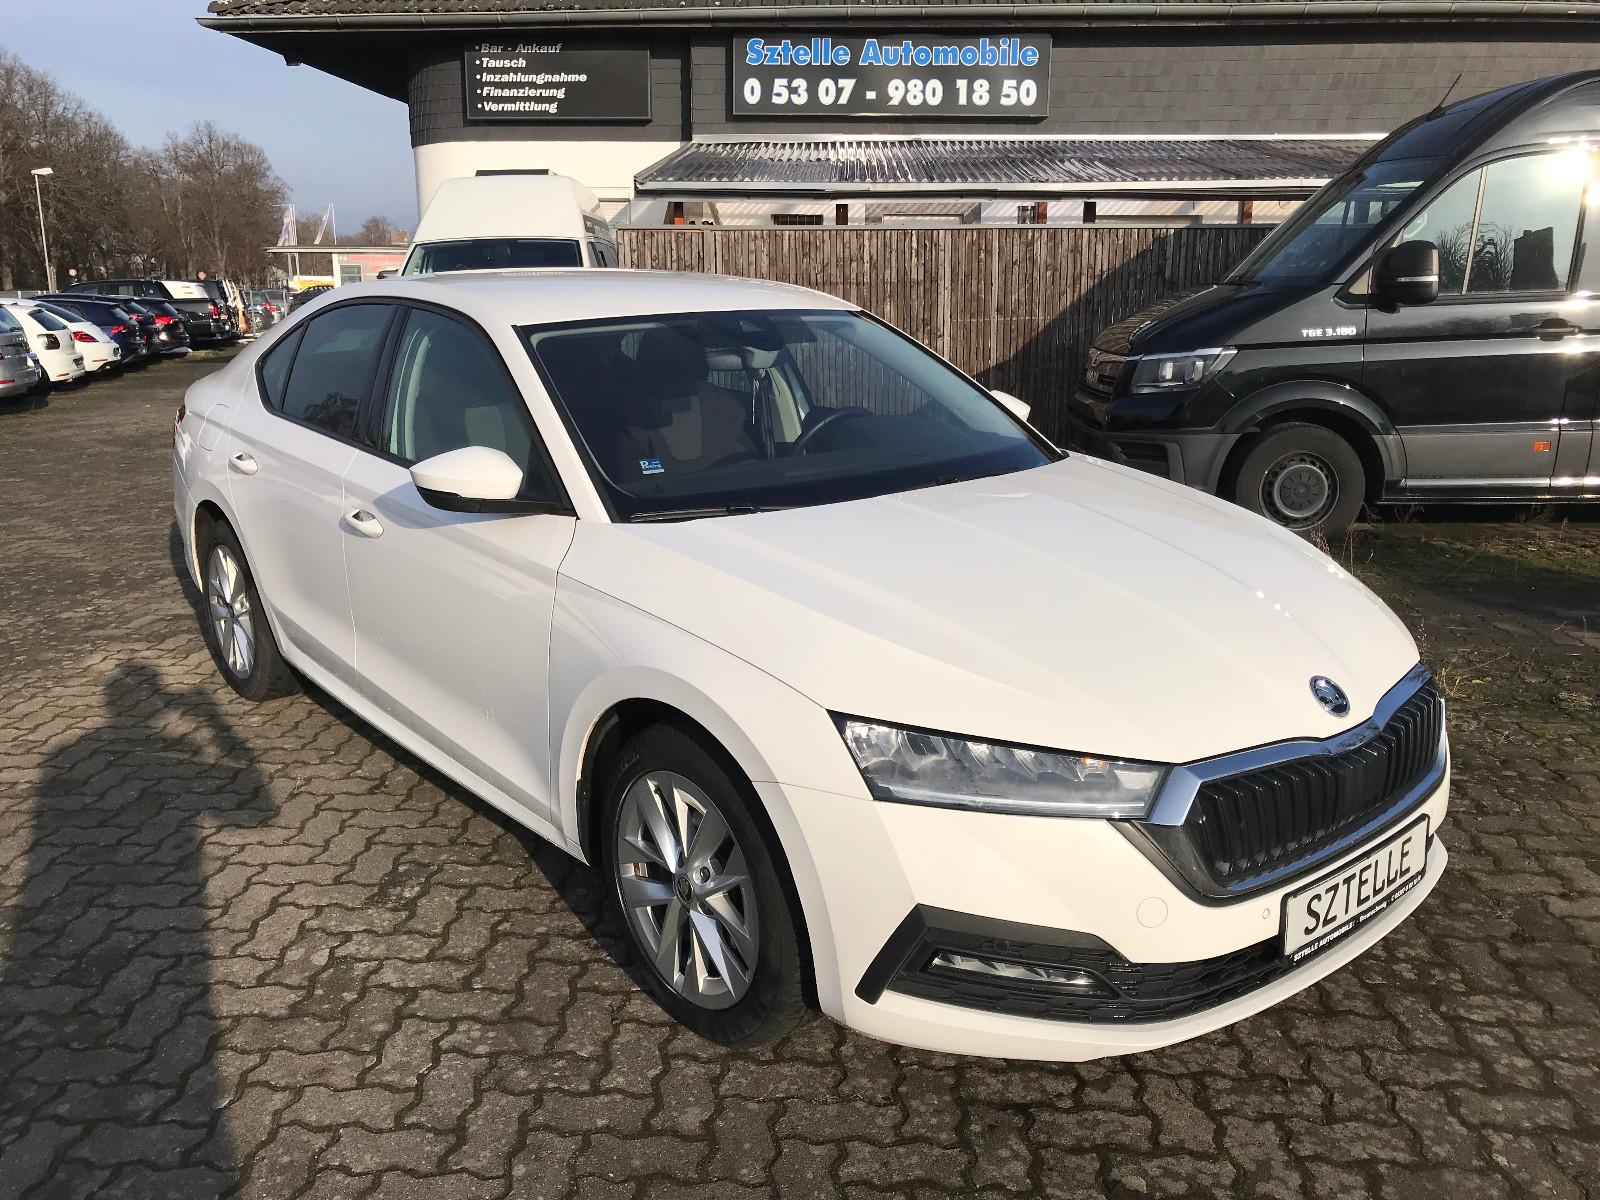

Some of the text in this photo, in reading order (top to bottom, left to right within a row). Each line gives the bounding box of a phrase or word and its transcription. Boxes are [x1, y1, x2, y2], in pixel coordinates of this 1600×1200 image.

[480, 43, 503, 53] Bar
[516, 43, 563, 53] Ankauf
[746, 37, 1040, 66] Sztelle Automobile
[481, 57, 527, 68] Tausch
[481, 72, 588, 84] Inzahlungnahme
[482, 86, 566, 98] Finanzierung
[743, 77, 762, 105] 0
[771, 77, 809, 105] 53
[817, 78, 857, 105] 07
[886, 78, 944, 106] 980
[955, 78, 991, 106] 18
[999, 79, 1038, 106] 50
[483, 101, 558, 113] Vermittlung
[1301, 328, 1324, 338] TGE
[1304, 836, 1412, 936] SZTELLE
